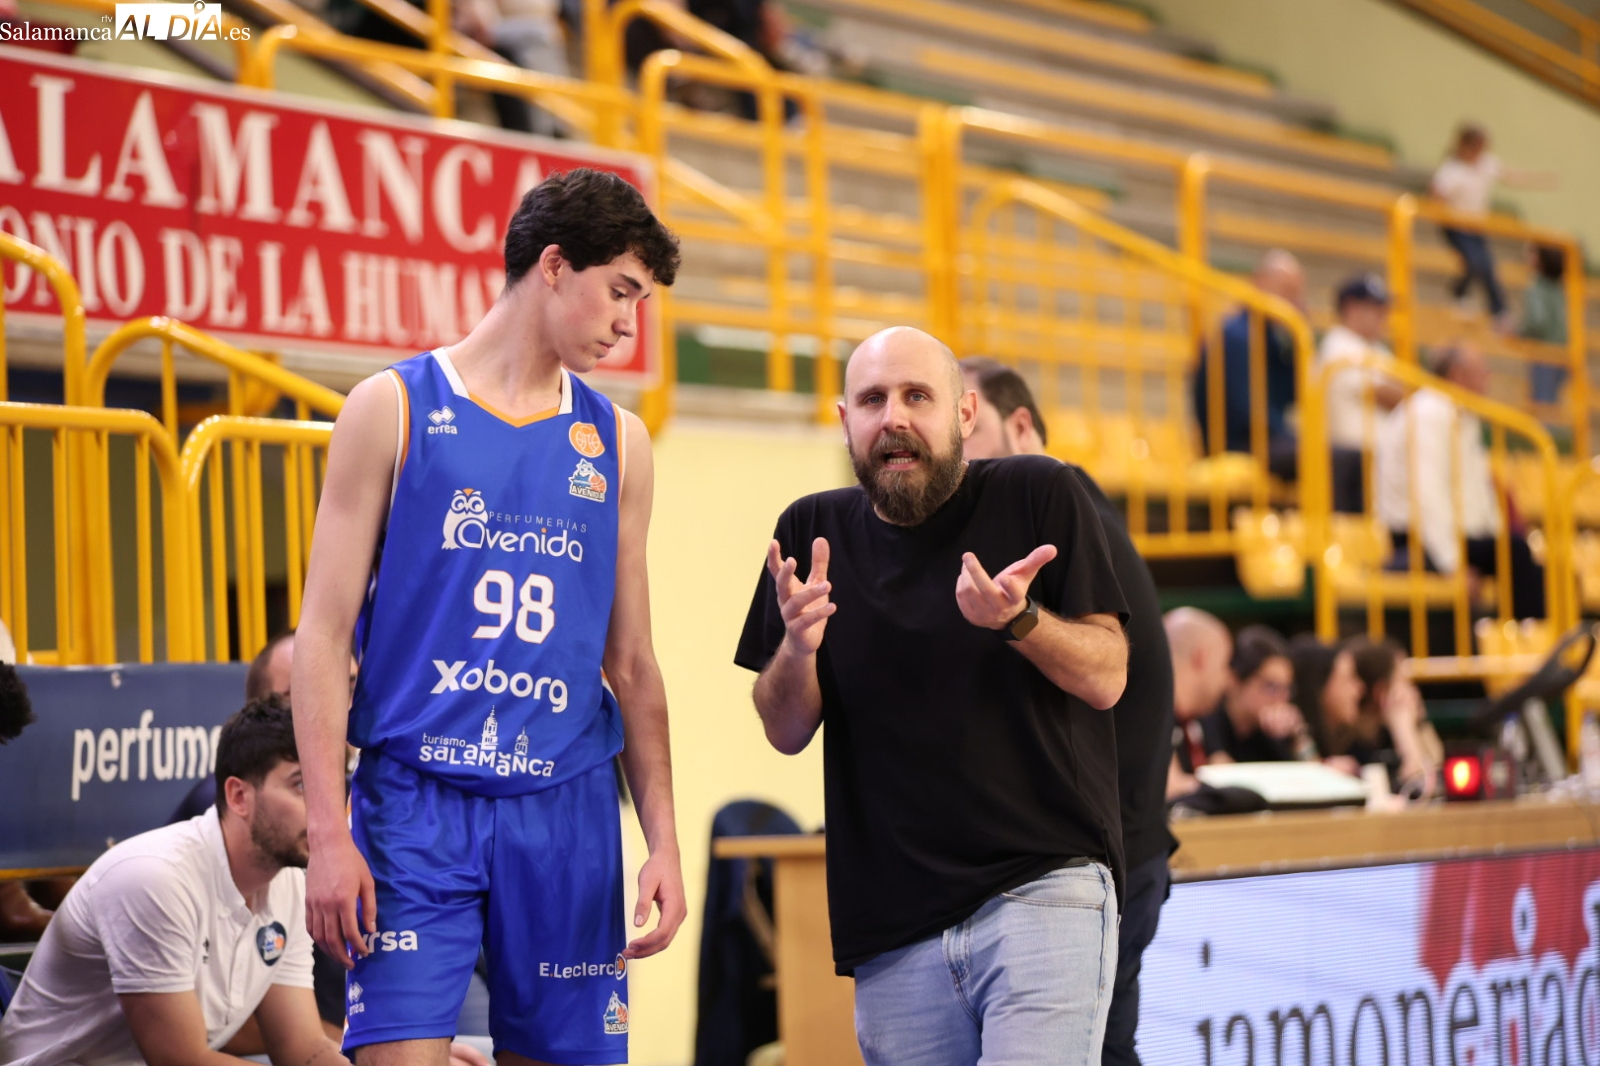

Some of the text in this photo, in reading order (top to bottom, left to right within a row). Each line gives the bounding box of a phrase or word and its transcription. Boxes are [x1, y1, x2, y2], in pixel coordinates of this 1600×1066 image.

[160, 228, 248, 328] DE
[259, 241, 335, 339] LA
[341, 250, 507, 349] HUMA
[489, 511, 587, 533] PERFUMERÍAS
[471, 569, 556, 645] 98
[430, 659, 568, 713] Xoborg
[422, 732, 467, 748] turismo
[539, 962, 615, 978] E.Leclerc
